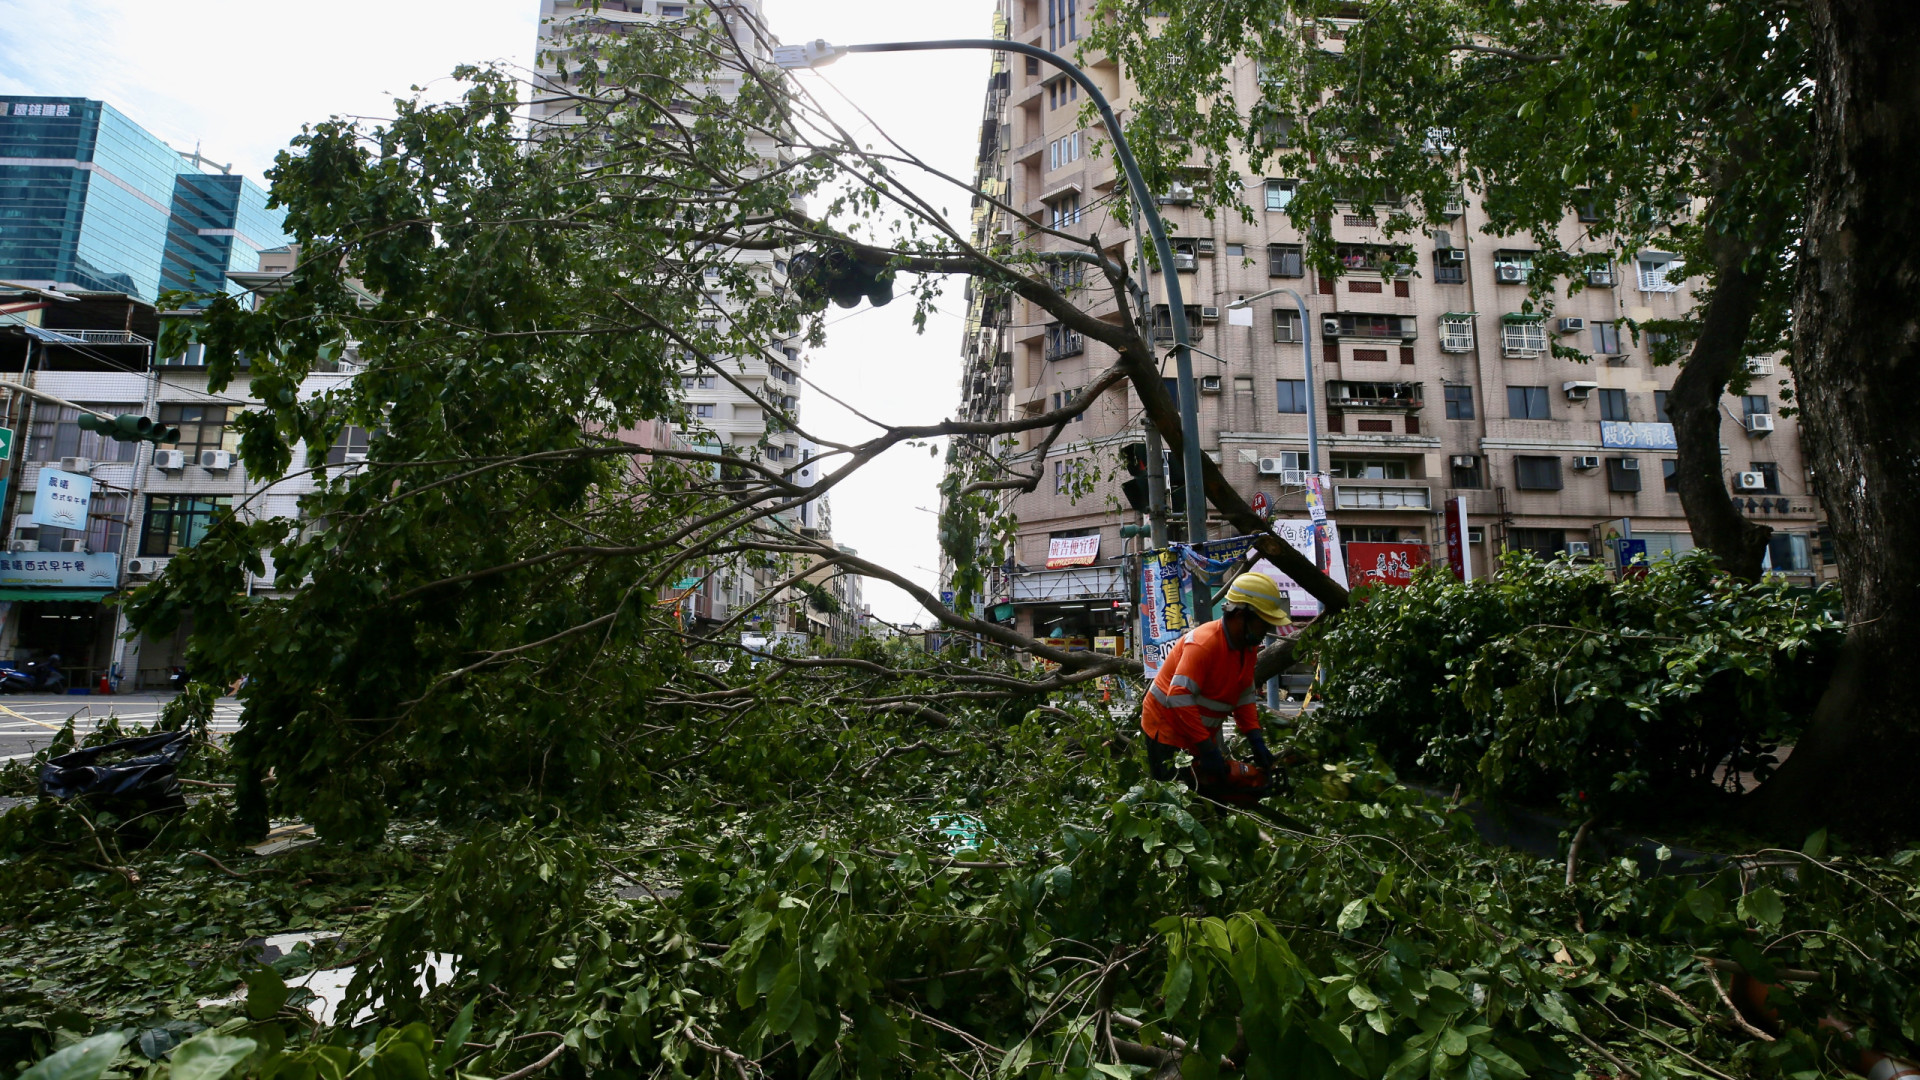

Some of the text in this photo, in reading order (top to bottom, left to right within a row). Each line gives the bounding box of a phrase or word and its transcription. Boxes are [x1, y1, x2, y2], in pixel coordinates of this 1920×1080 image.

[1602, 424, 1675, 447] 股份有限
[51, 492, 88, 506] 西式早午餐
[1049, 537, 1098, 556] 廣告便宜租
[1620, 541, 1631, 553] P
[0, 559, 86, 572] 晨曦西式早午餐
